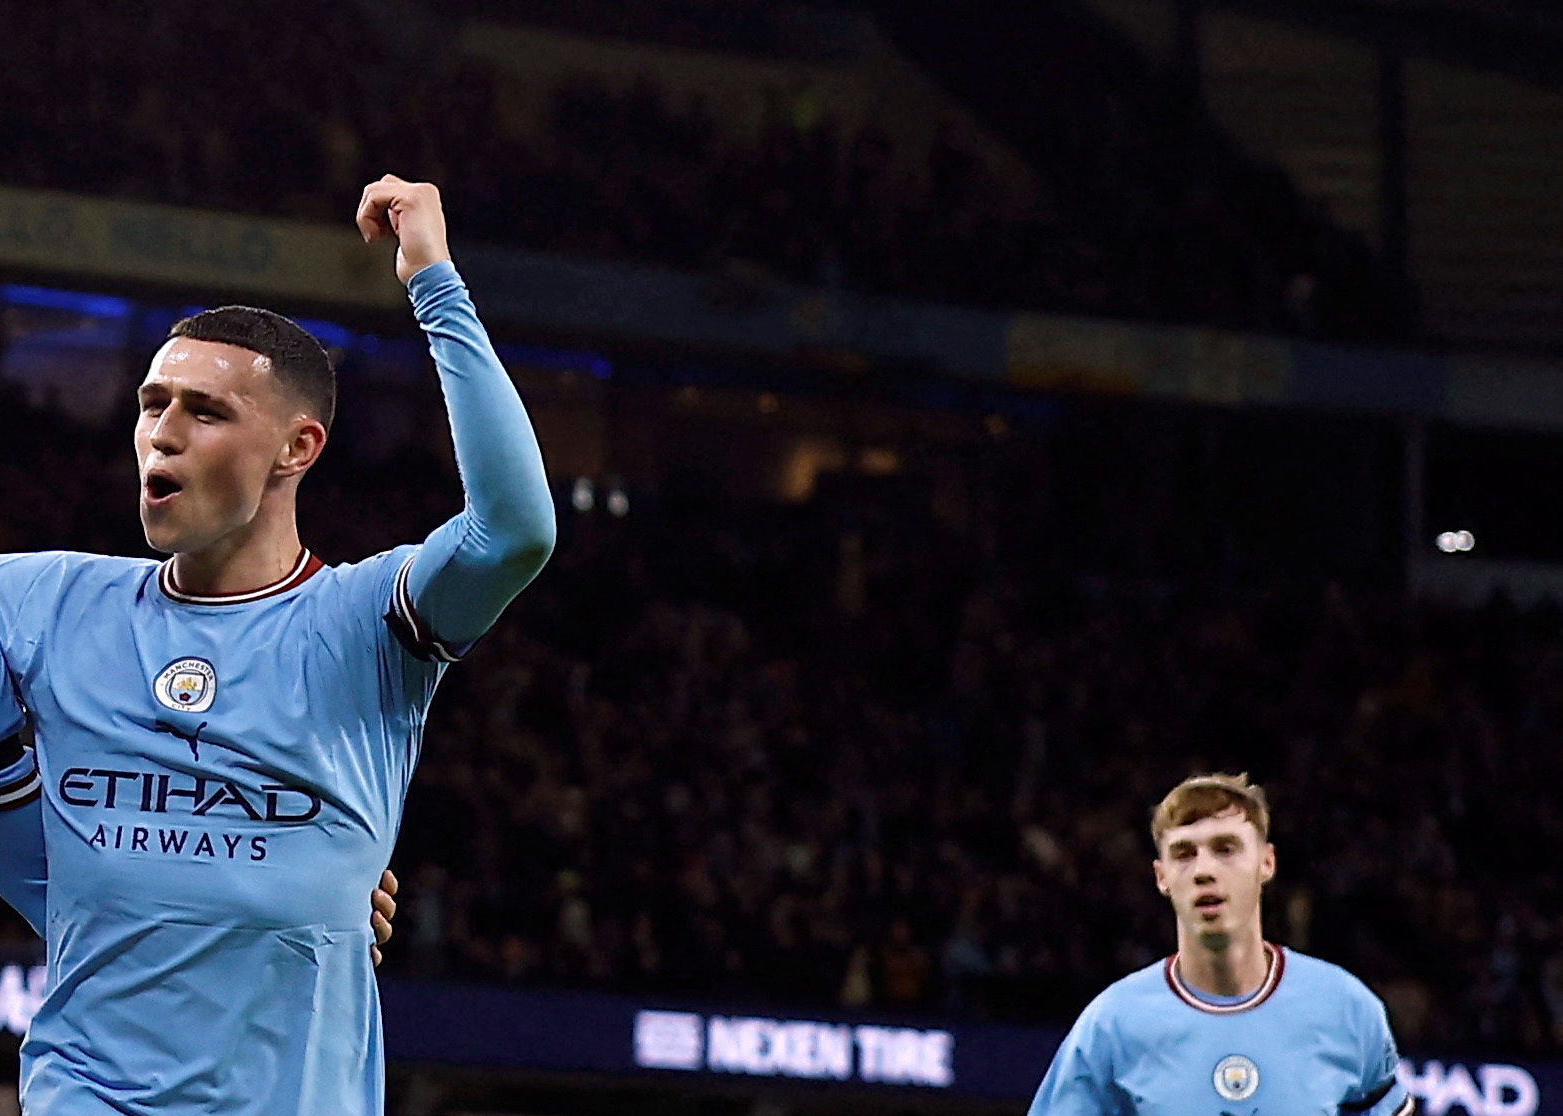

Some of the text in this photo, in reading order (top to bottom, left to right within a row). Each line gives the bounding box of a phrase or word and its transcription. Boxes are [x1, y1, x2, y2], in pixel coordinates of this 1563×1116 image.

[163, 662, 214, 681] MANCHESTER
[59, 767, 322, 822] ETIHAD
[89, 824, 268, 861] AIRWAYS
[706, 1014, 956, 1089] NEXEN TIRE
